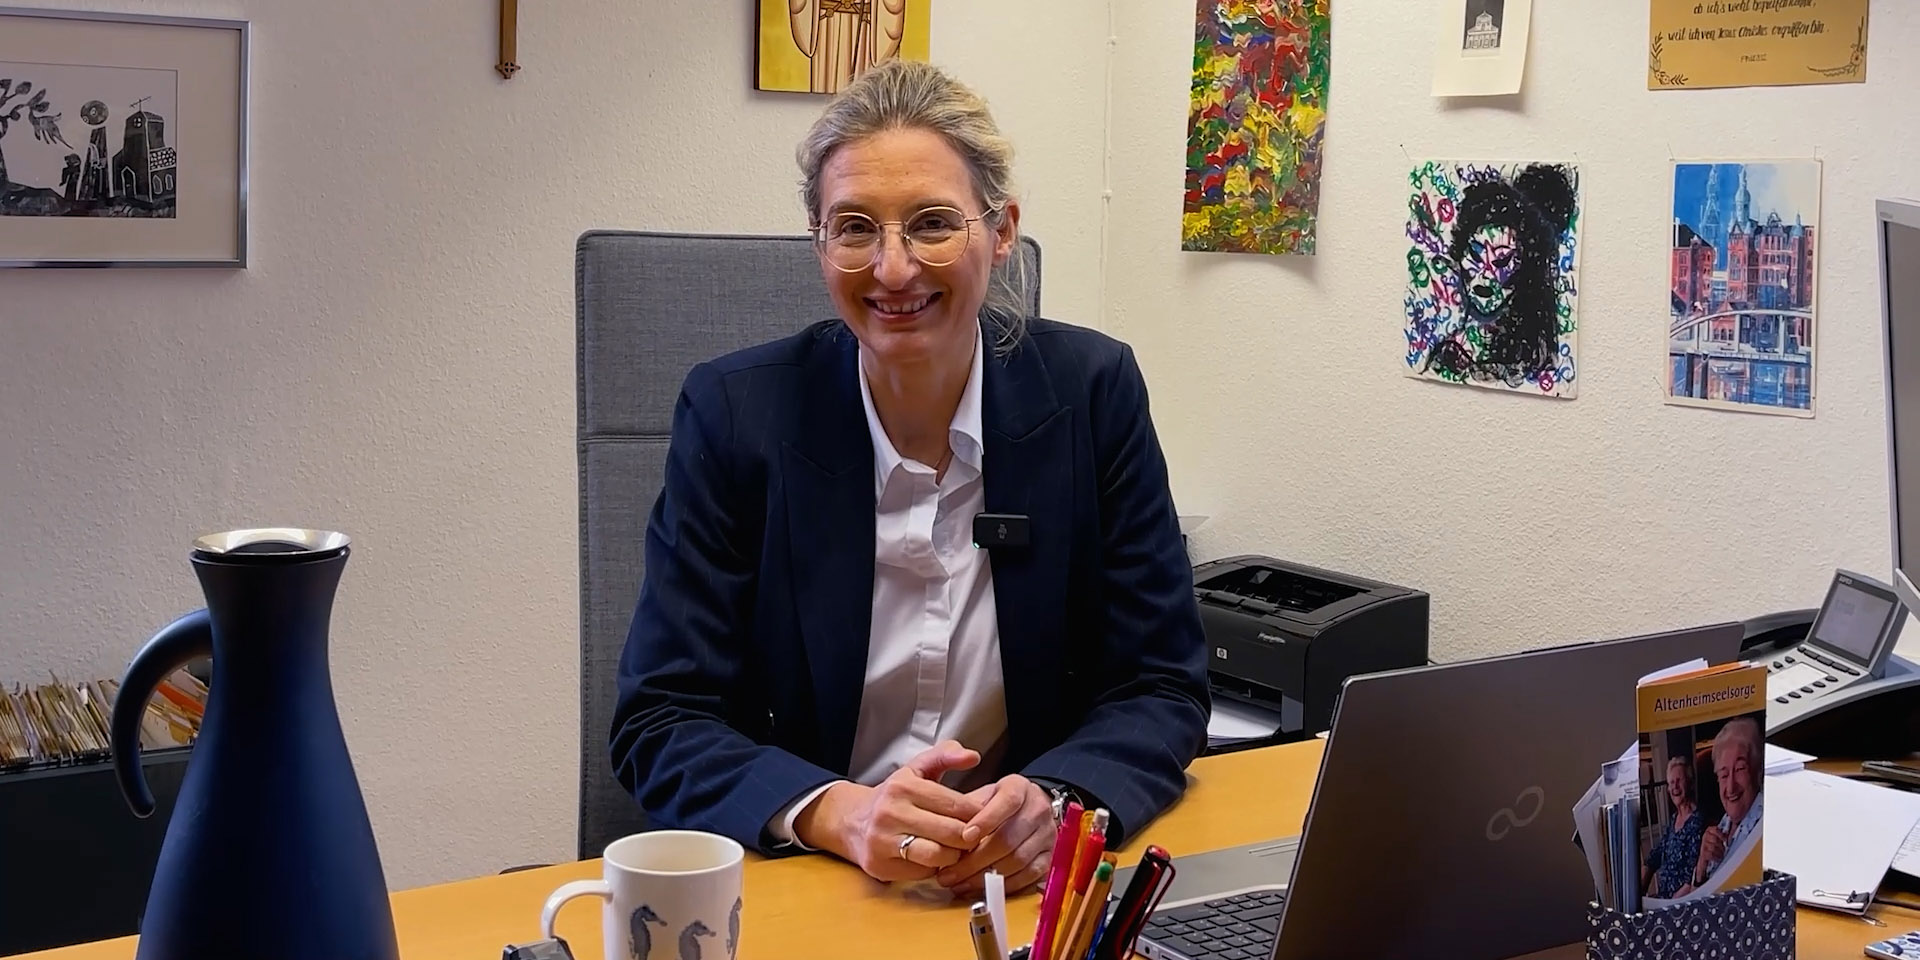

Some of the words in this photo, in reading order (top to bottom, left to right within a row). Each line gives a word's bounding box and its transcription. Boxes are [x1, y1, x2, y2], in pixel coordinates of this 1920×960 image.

[1667, 27, 1686, 41] weil
[1688, 27, 1700, 41] ich
[1654, 684, 1756, 712] Altenheimseelsorge
